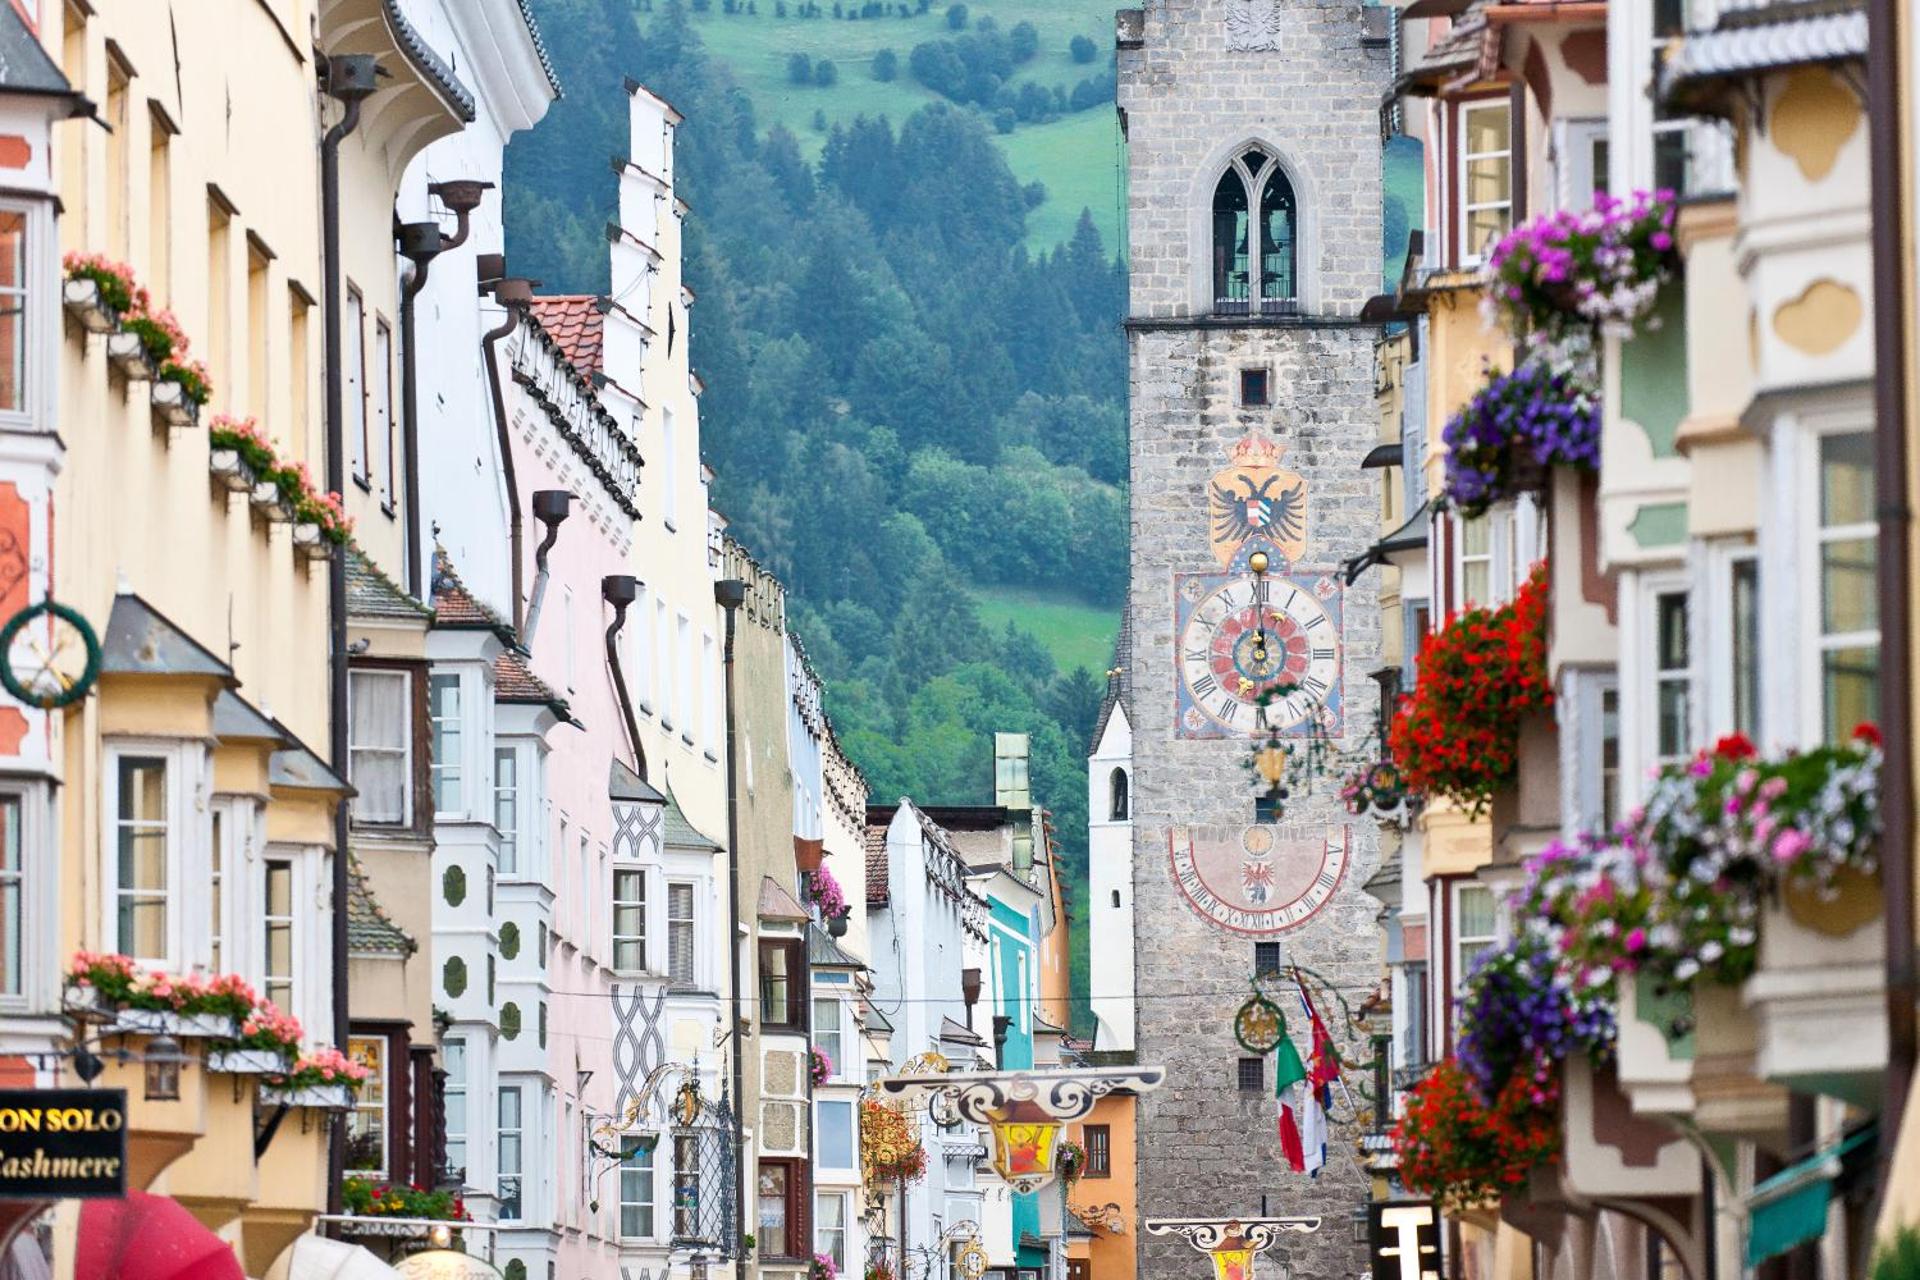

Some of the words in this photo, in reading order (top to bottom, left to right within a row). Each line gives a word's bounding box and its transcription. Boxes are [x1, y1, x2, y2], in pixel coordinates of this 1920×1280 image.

[0, 1108, 42, 1132] ON
[46, 1108, 122, 1132] SOLO
[0, 1147, 120, 1179] ashmere
